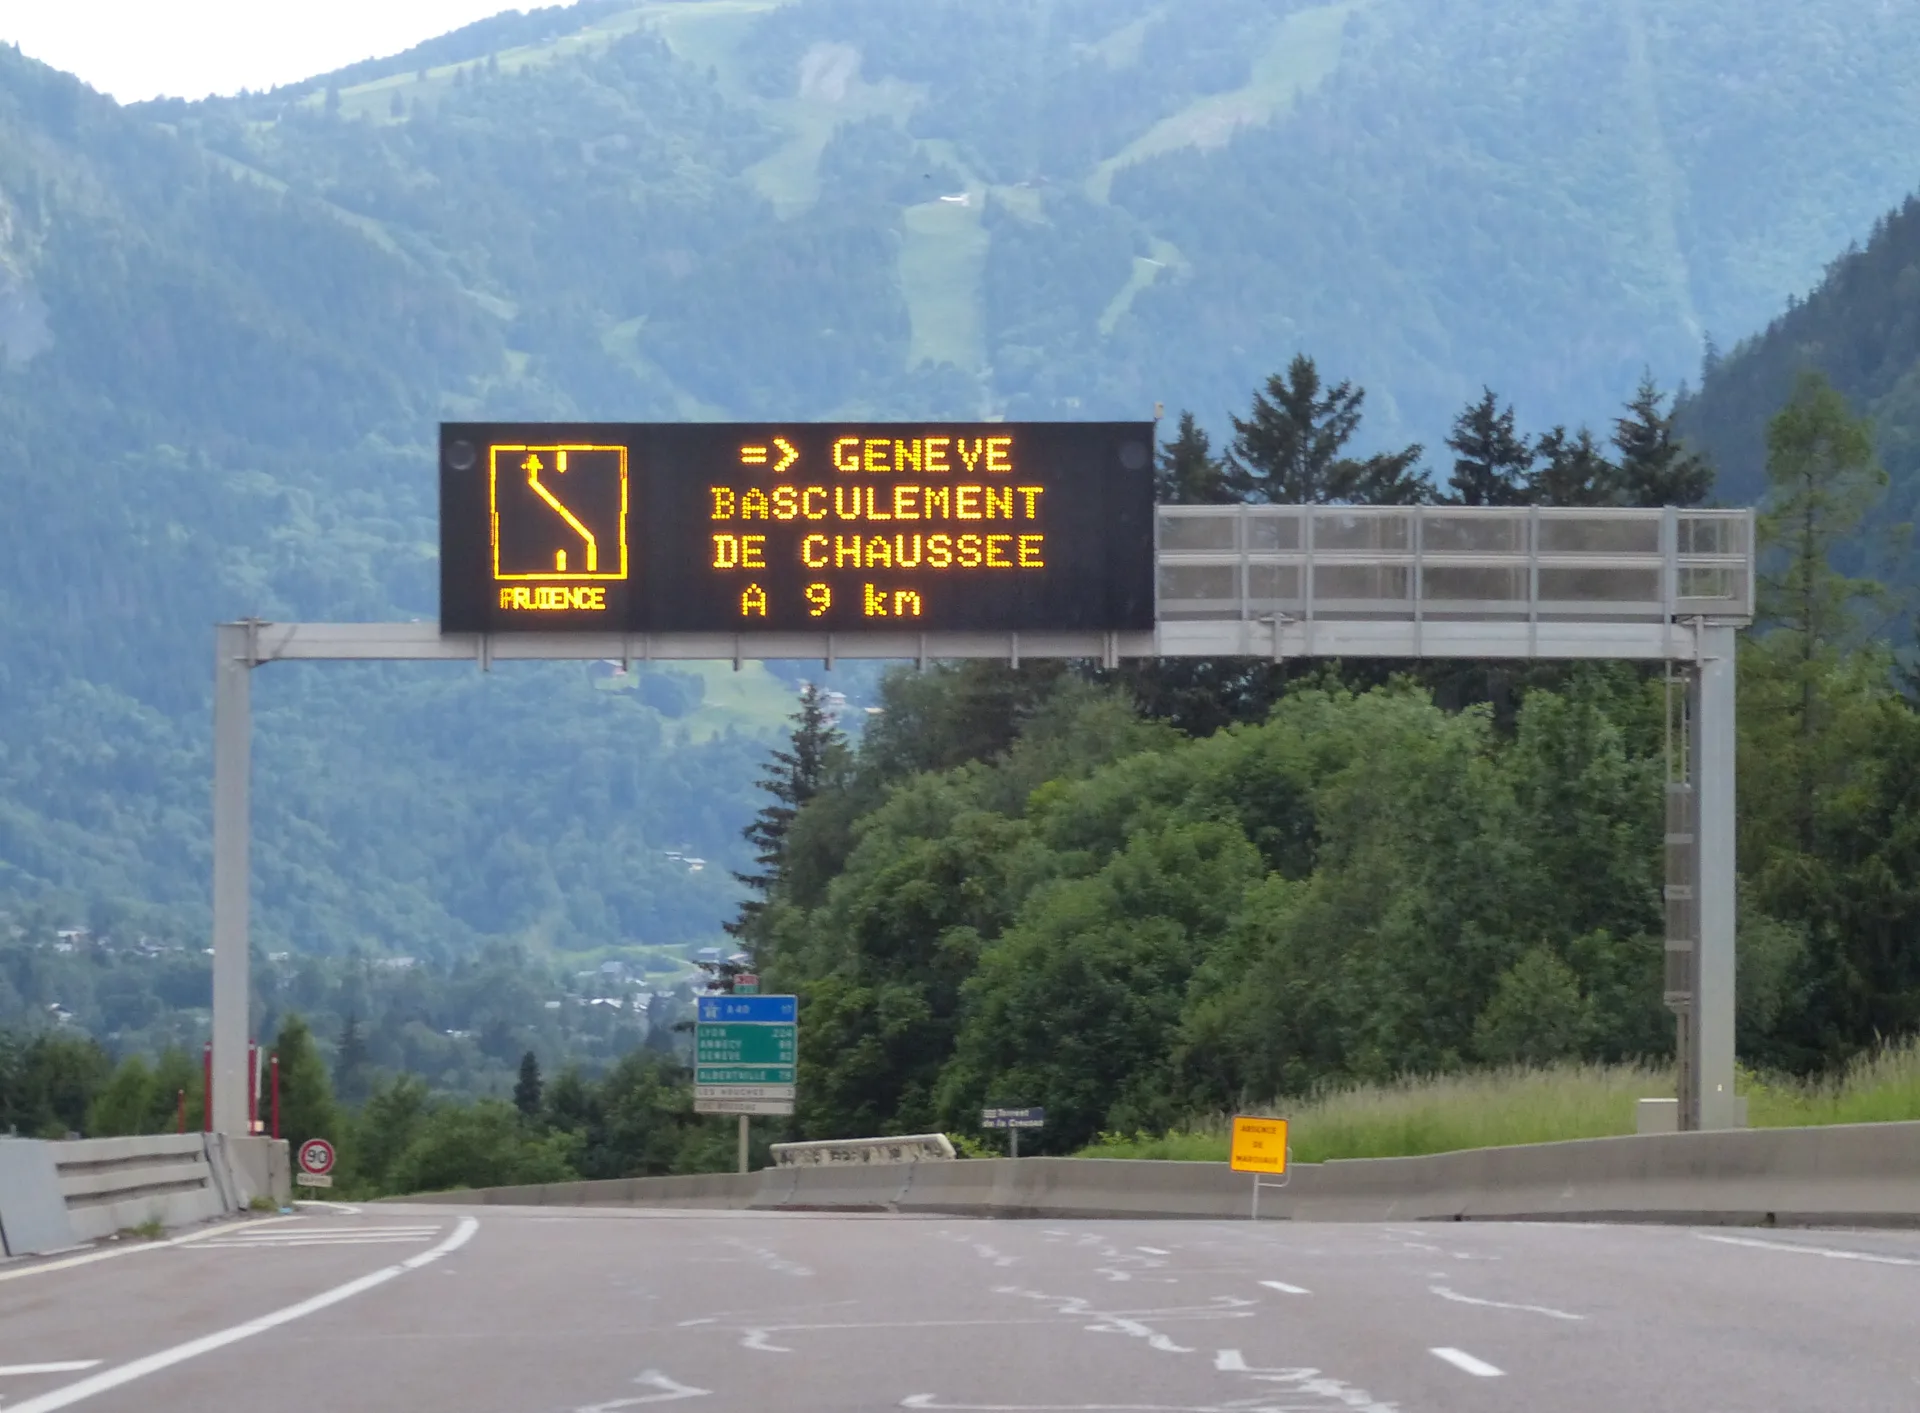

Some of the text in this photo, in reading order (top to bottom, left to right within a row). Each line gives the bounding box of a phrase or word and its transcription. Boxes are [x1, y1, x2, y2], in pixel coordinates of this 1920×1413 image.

[832, 436, 1013, 473] GENEVE
[710, 485, 1043, 521] BASCULEMENT
[712, 533, 1044, 569] DE CHAUSSEE
[499, 586, 606, 610] PRUDENCE
[740, 584, 923, 617] A 9 km
[306, 1149, 327, 1163] 90
